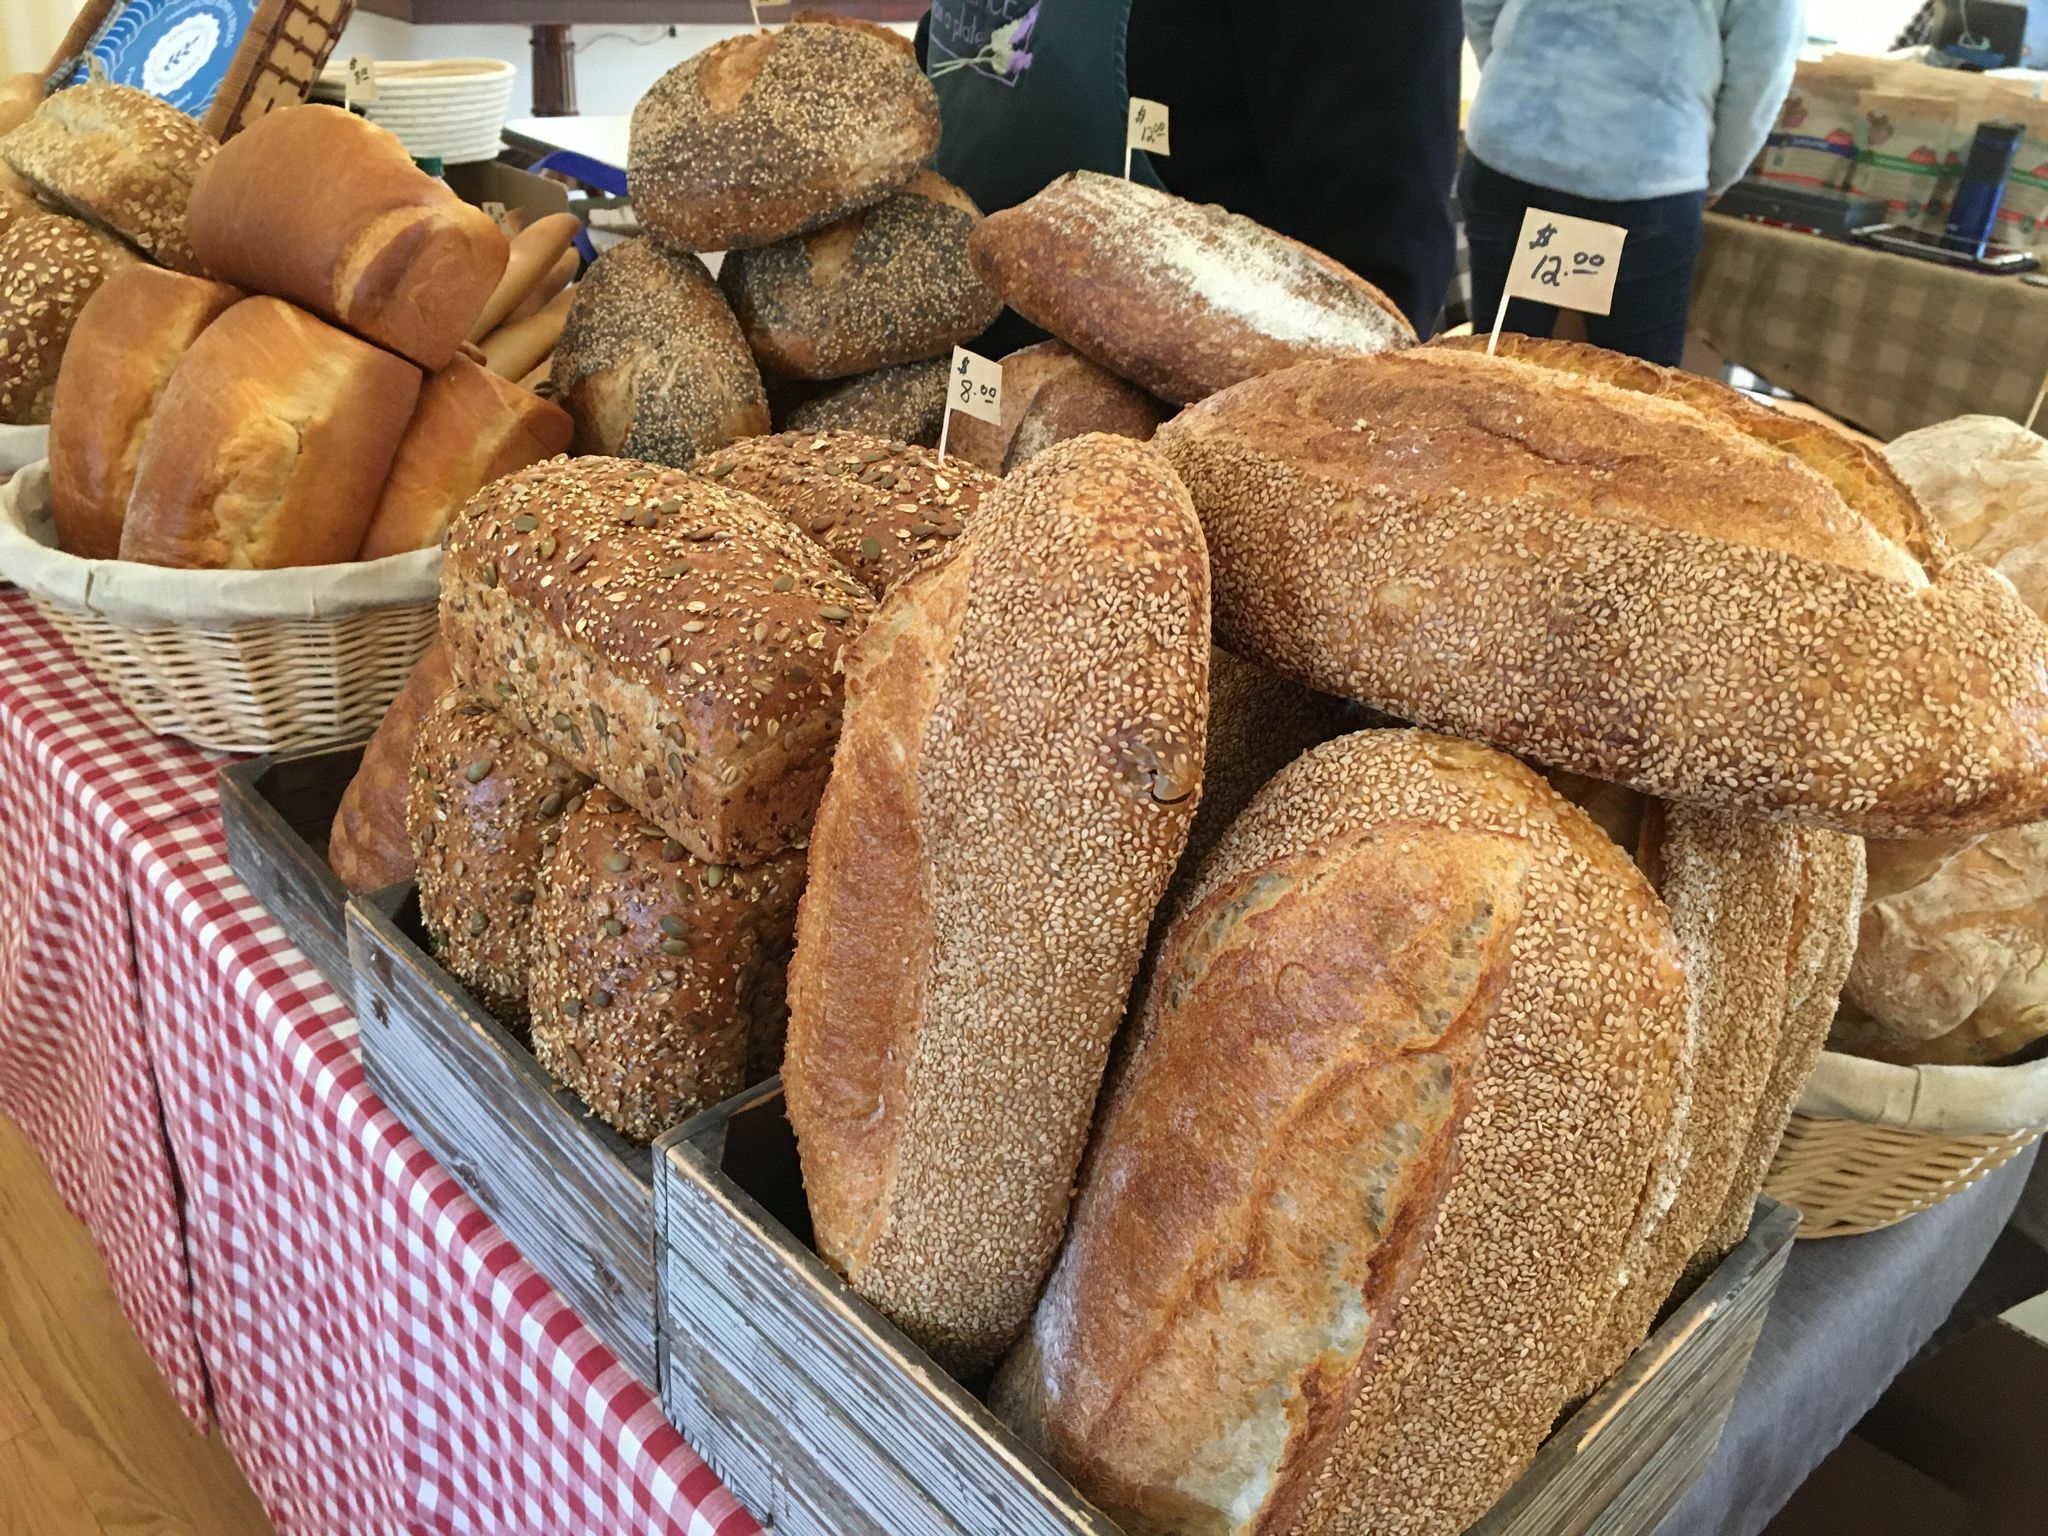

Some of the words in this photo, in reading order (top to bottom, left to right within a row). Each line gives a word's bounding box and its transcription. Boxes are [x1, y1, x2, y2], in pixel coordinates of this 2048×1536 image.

[1528, 222, 1558, 250] $
[1530, 251, 1606, 287] 12.00
[957, 356, 970, 376] $
[960, 379, 997, 404] 8.00
